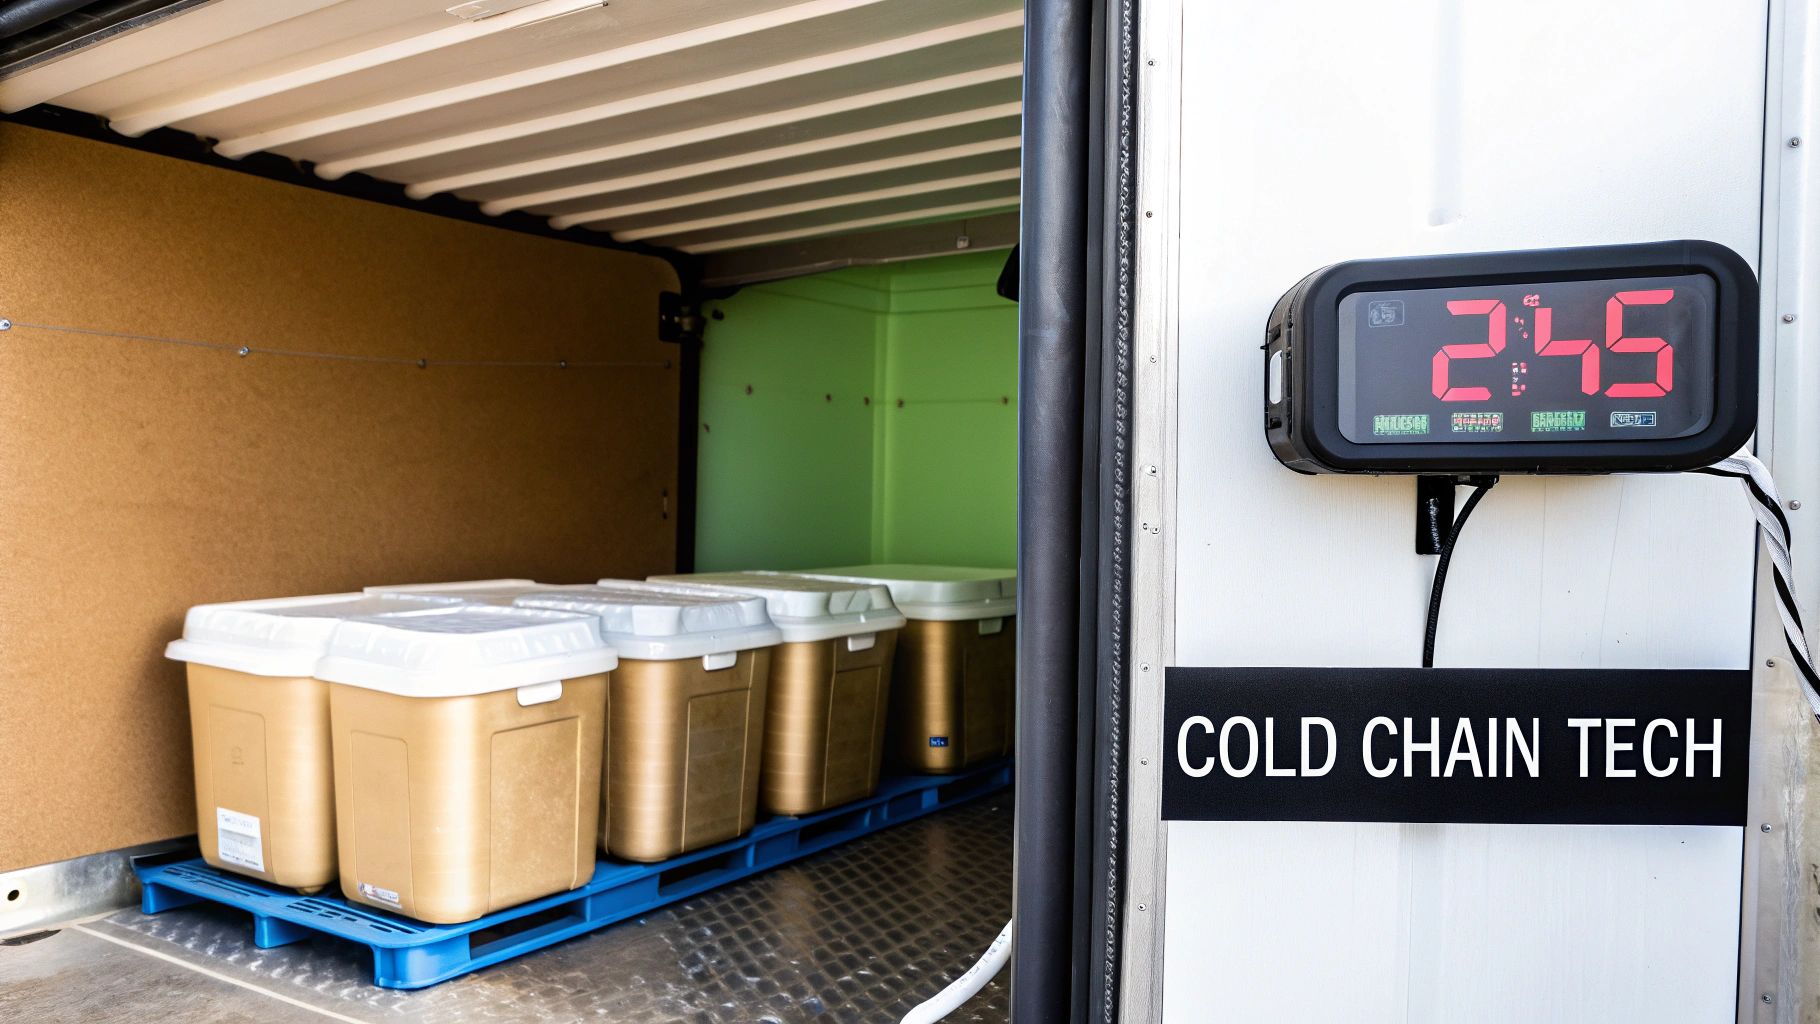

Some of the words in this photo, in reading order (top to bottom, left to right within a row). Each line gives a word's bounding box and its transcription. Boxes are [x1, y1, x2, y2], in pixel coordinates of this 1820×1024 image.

[1177, 715, 1337, 778] COLD
[1362, 716, 1540, 778] CHAIN
[1567, 717, 1722, 778] TECH
